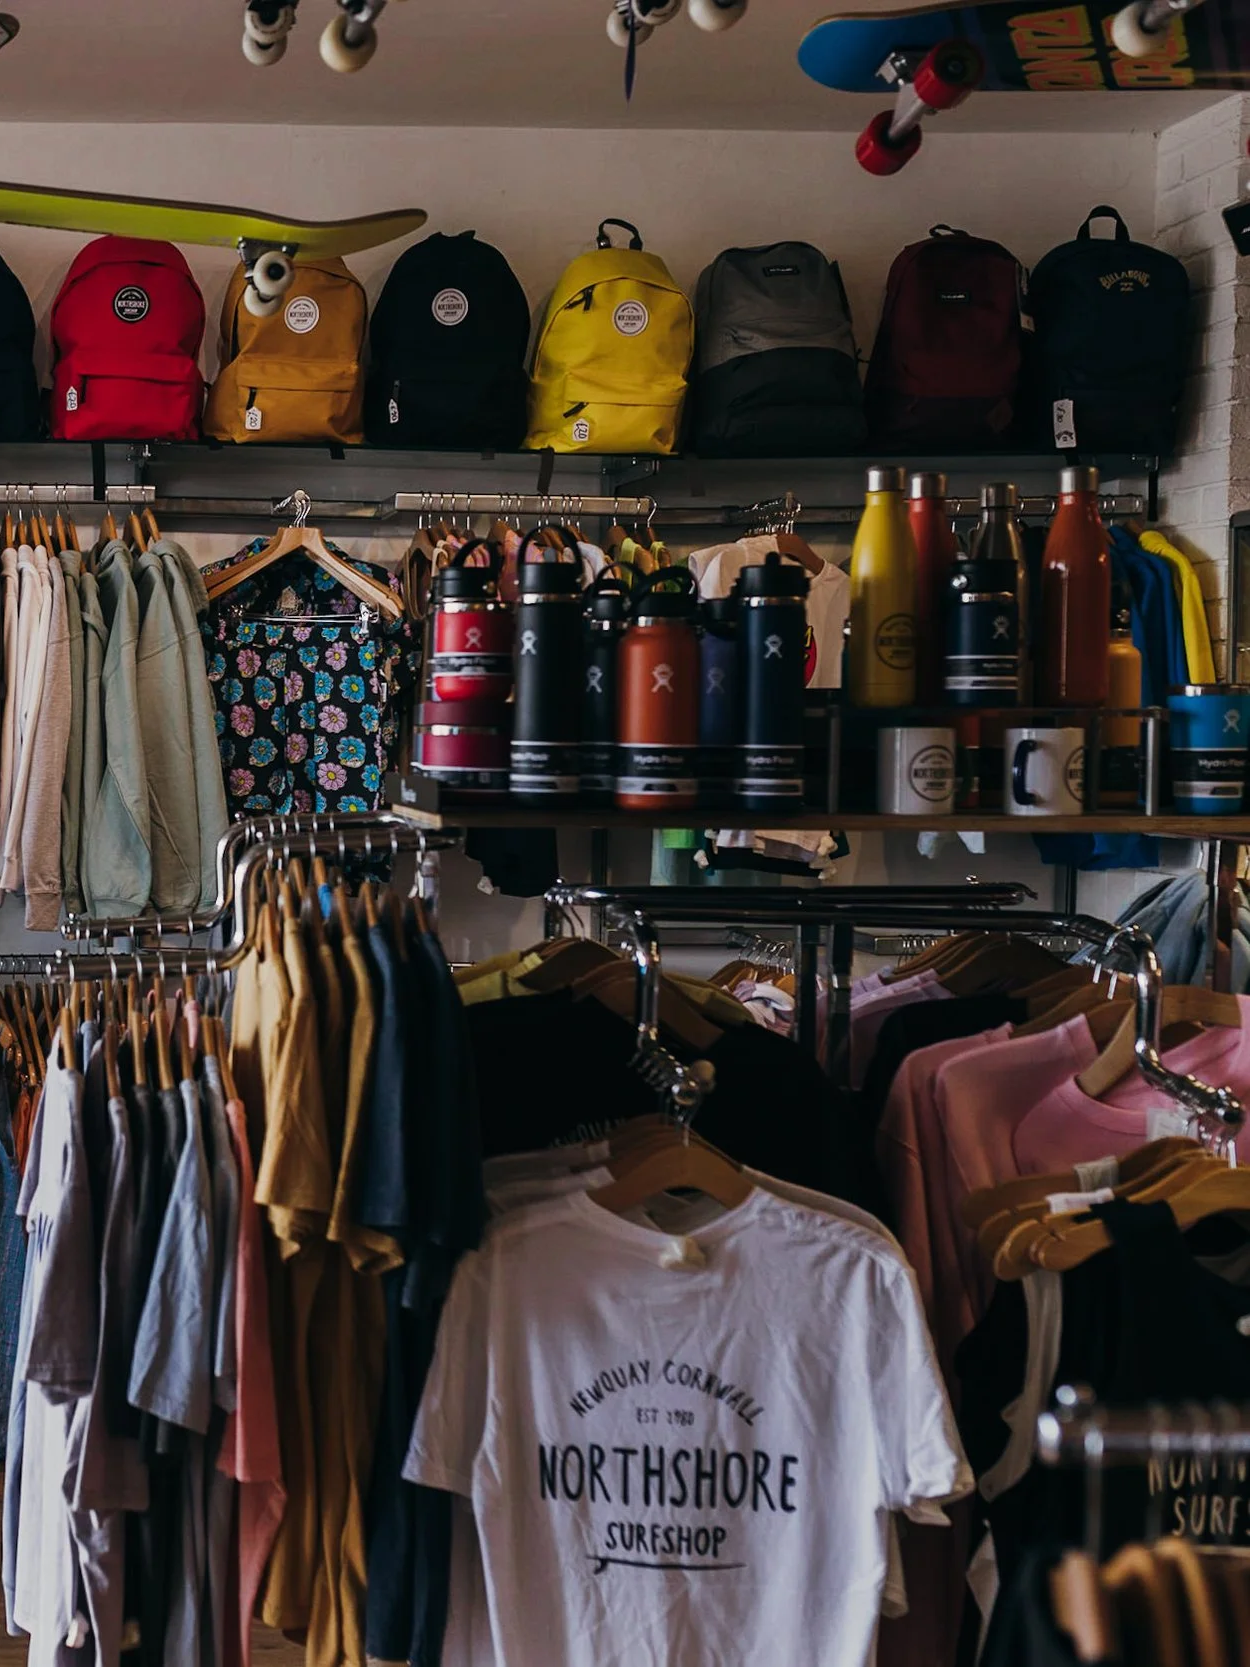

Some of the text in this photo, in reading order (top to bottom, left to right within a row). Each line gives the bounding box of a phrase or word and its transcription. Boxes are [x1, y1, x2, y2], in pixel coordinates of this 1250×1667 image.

[1005, 4, 1106, 90] ANTA
[248, 411, 258, 427] £20
[570, 1359, 765, 1427] NEWQUAY CORNWALL
[636, 1408, 660, 1425] EST
[538, 1442, 799, 1513] NORTHSHORE
[1171, 1494, 1250, 1537] SURF
[605, 1521, 727, 1558] SURFSHOP
